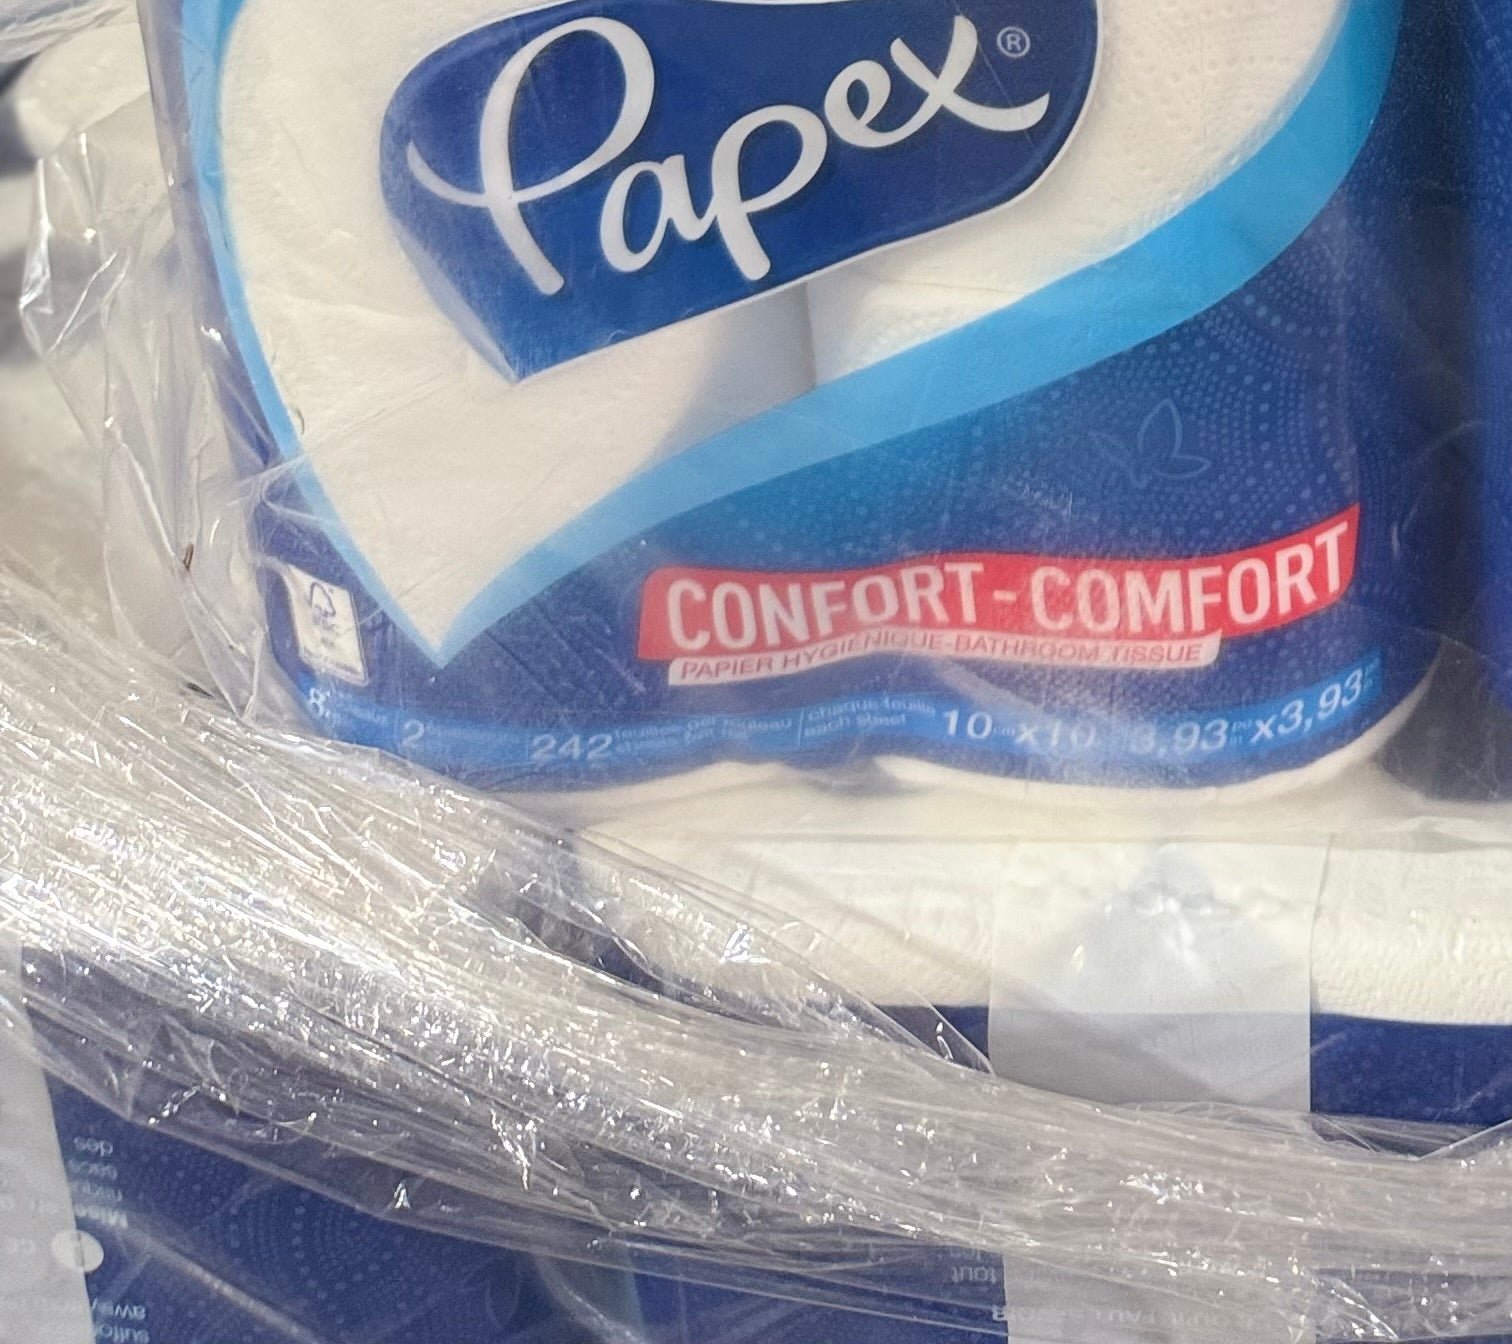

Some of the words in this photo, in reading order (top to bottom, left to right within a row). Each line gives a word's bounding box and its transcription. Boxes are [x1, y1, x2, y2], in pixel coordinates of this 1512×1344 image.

[680, 655, 774, 681] PAPIER
[1107, 641, 1203, 666] TISSUE
[530, 732, 615, 761] 242
